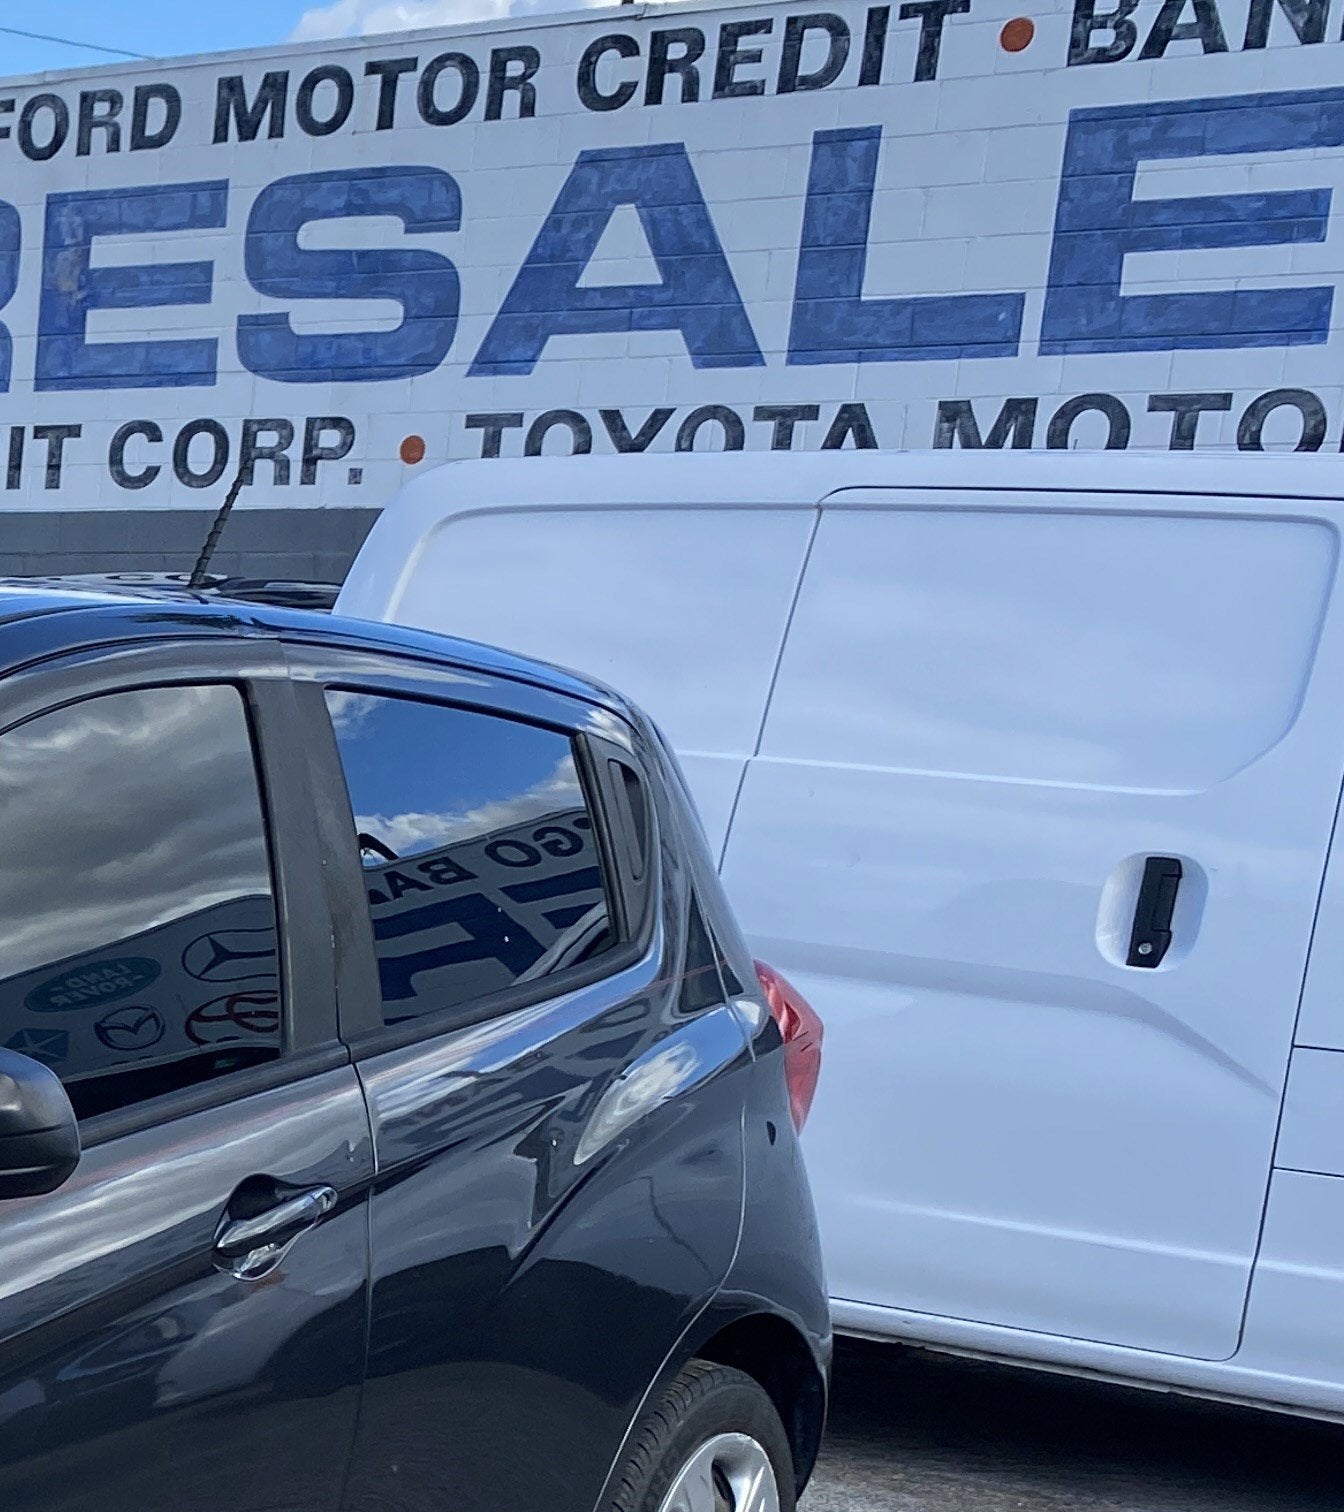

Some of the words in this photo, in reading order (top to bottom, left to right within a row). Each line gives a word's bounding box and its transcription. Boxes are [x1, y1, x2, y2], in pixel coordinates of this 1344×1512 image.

[212, 46, 540, 144] MOTOR
[577, 0, 970, 111] CREDIT
[1066, 0, 1344, 67] BAN
[109, 417, 363, 491] CORP.
[465, 403, 879, 457] TOYOTA
[933, 388, 1344, 451] MOTO
